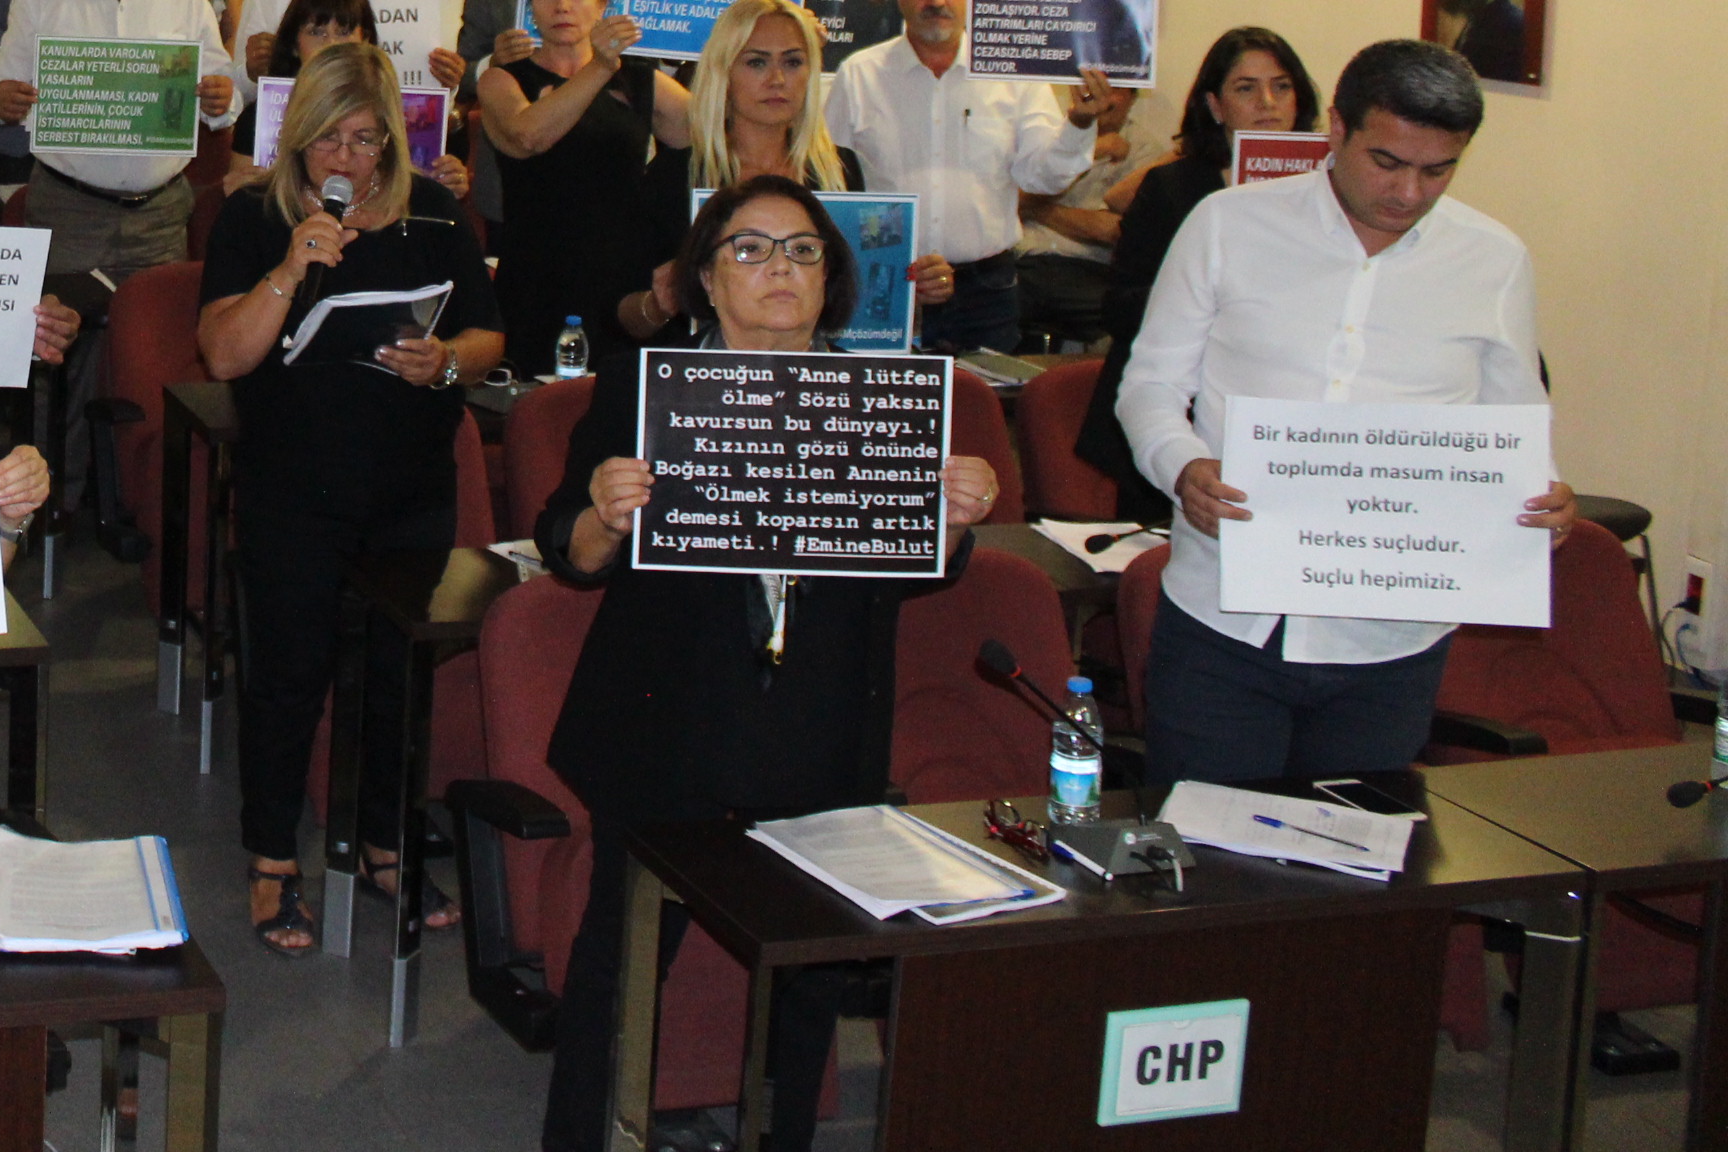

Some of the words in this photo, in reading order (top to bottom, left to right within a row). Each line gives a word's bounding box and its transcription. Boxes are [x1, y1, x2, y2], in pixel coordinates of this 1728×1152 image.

[634, 0, 672, 14] EŞİTLİK
[674, 3, 688, 16] VE
[1042, 6, 1069, 17] CEZA
[974, 18, 1044, 31] ARTTIRIMLARI
[974, 33, 1011, 44] OLMAK
[1012, 32, 1048, 45] YERİNE
[41, 45, 107, 58] KANUNLARDA
[109, 48, 156, 60] VAROLAN
[974, 47, 1039, 60] CEZASIZLIĞA
[1040, 49, 1072, 61] SEBEP
[40, 60, 86, 72] CEZALAR
[86, 60, 125, 73] YETERLİ
[125, 62, 160, 74] SORUN
[974, 61, 1017, 73] OLUYOR.
[40, 74, 94, 86] YASALARIN
[128, 91, 160, 103] KADIN
[108, 105, 144, 118] ÇOCUK
[38, 115, 131, 130] İSTİSMARCILARININ
[37, 131, 80, 143] SERBEST
[1245, 157, 1283, 172] KADIN
[658, 364, 672, 379] O
[684, 365, 774, 388] çocuğun
[863, 368, 941, 386] lütfen
[798, 391, 850, 408] Sözü
[862, 393, 941, 412] yaksın
[669, 412, 773, 431] kavursun
[784, 415, 812, 432] bu
[823, 416, 936, 437] dünyayı.!
[1253, 425, 1281, 442] Bir
[1286, 427, 1359, 445] kadının
[1366, 428, 1488, 452] öldürüldüğü
[1495, 433, 1522, 450] bir
[694, 438, 786, 455] Kızının
[797, 441, 849, 459] gözü
[861, 442, 939, 459] önünde
[655, 460, 732, 481] Boğazı
[745, 463, 835, 481] kesilen
[847, 464, 937, 483] Annenin
[1268, 460, 1364, 480] toplumda
[1371, 466, 1443, 482] masum
[1450, 467, 1504, 484] insan
[1347, 496, 1418, 515] yoktur.
[666, 509, 743, 527] demesi
[756, 511, 860, 532] koparsın
[872, 515, 935, 531] artık
[651, 531, 779, 552] kıyameti.!
[793, 536, 935, 555] #EmineBulut
[1299, 530, 1367, 549] Herkes
[1373, 534, 1465, 554] suçludur.
[1302, 568, 1354, 588] Suçlu
[1360, 569, 1461, 591] hepimiziz.
[1136, 1040, 1225, 1086] CHP
